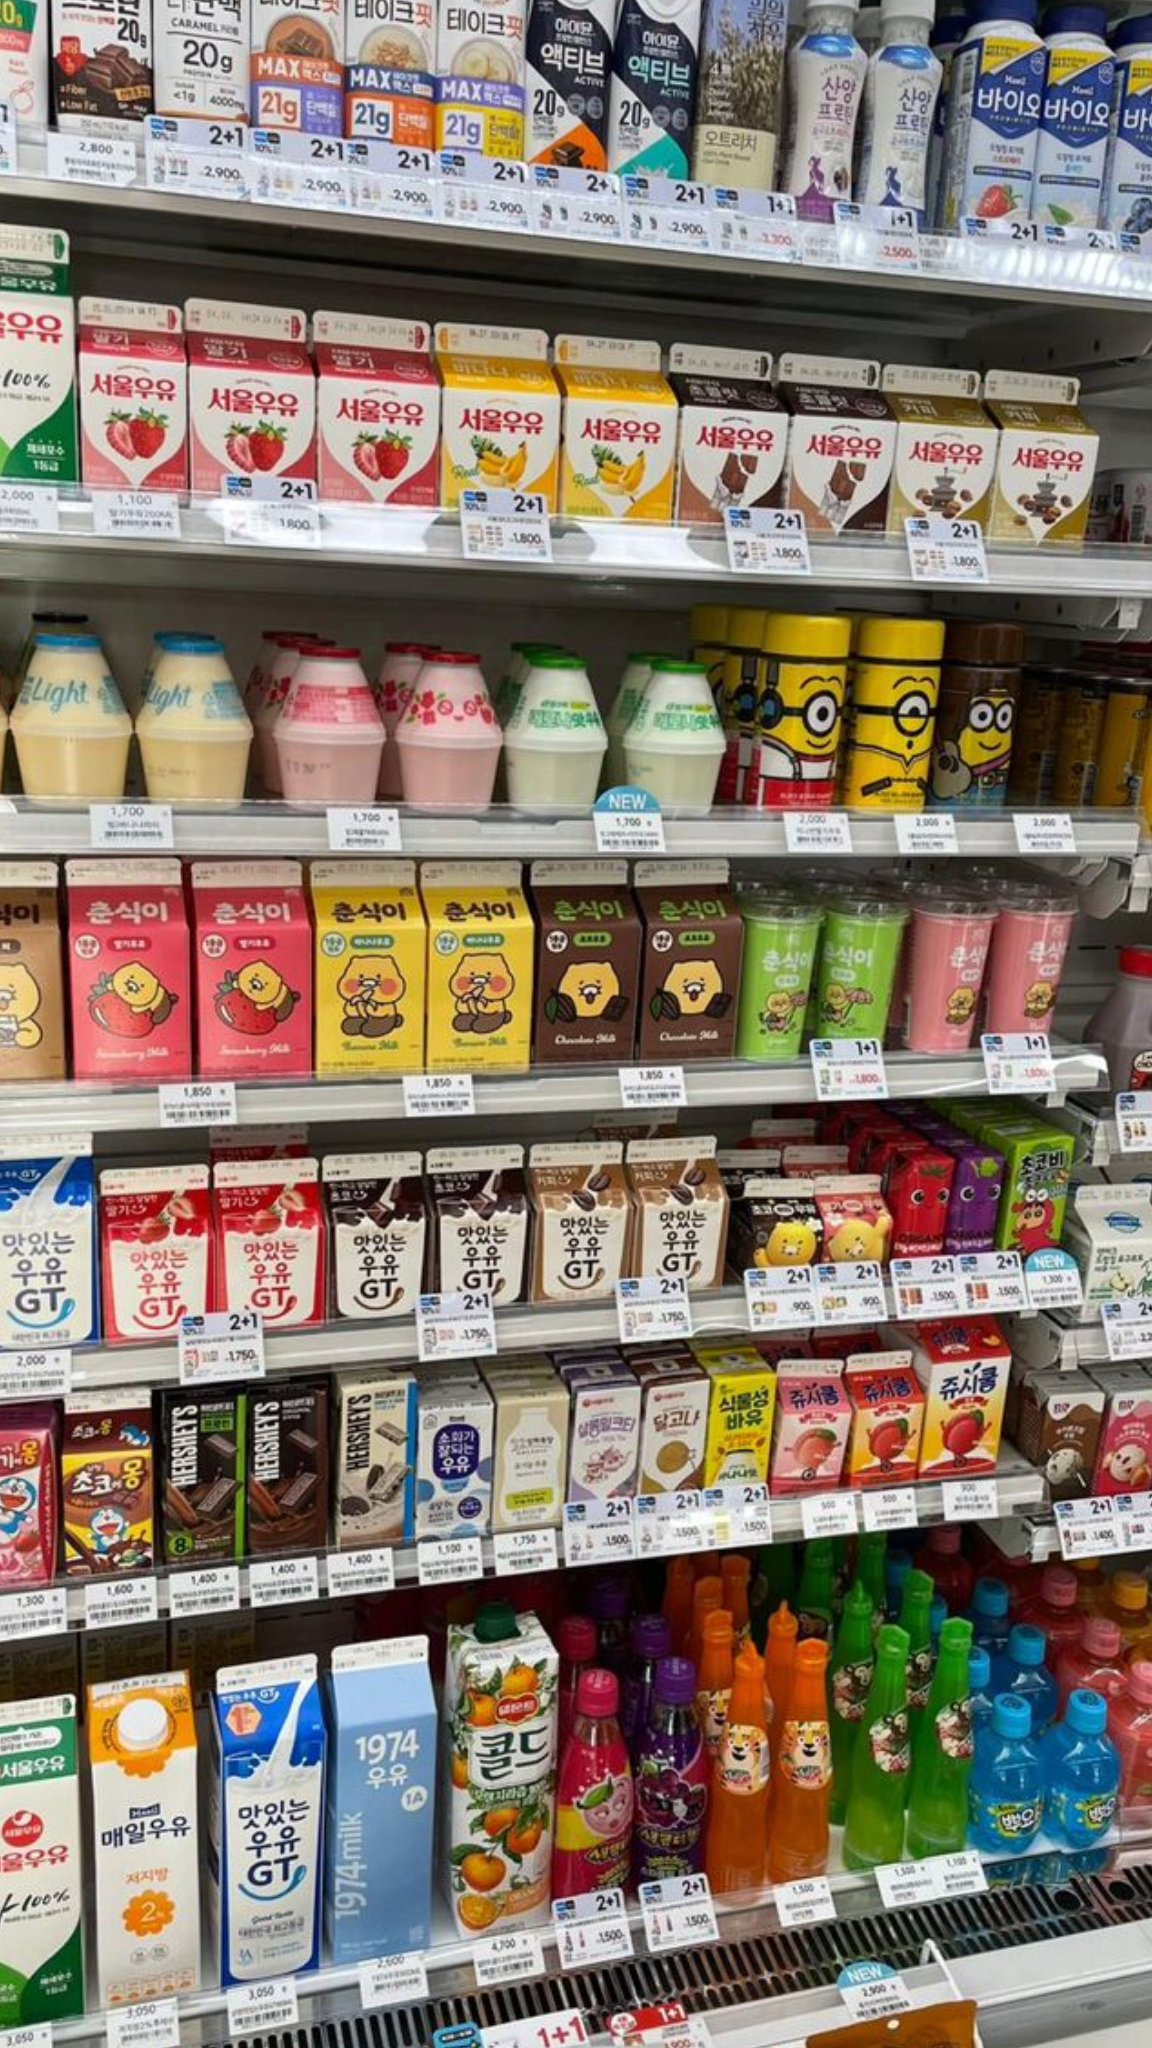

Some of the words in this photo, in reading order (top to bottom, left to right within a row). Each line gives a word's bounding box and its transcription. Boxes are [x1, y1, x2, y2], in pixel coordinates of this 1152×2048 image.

[117, 17, 147, 49] 20g
[171, 17, 219, 34] CARAMEL
[447, 8, 524, 40] 테이크핏
[182, 39, 234, 73] 20g
[540, 42, 605, 76] 액티브
[258, 58, 300, 79] MAX
[628, 54, 690, 88] 액티브
[349, 70, 391, 91] MAX
[441, 80, 482, 102] MAX
[574, 76, 605, 88] ACTIVE
[822, 76, 857, 103] 산양
[533, 89, 565, 118] 20g
[660, 87, 690, 100] ACTIVE
[899, 87, 933, 113] 산양
[978, 87, 1041, 119] 바이오
[261, 90, 298, 123] 21g
[619, 99, 651, 130] 20g
[1044, 98, 1110, 129] 바이오
[354, 102, 391, 134] 21g
[209, 125, 244, 148] 2+1
[445, 113, 482, 145] 21g
[79, 142, 114, 155] 2,800
[310, 138, 344, 160] 2+1
[705, 131, 758, 152] 오트리치
[397, 150, 431, 171] 2+1
[493, 162, 526, 184] 2+1
[674, 184, 706, 205] 2+1
[1011, 223, 1039, 241] 2+1
[91, 373, 176, 402] 서울우유
[207, 387, 299, 417] 서울우유
[336, 397, 424, 426] 서울우유
[459, 407, 544, 435] 서울우유
[580, 418, 662, 444] 서울우유
[696, 425, 775, 452] 서울우유
[806, 434, 882, 460] 서울우유
[909, 440, 984, 466] 서울우유
[1012, 446, 1085, 473] 서울우유
[117, 494, 153, 506] 1,100
[282, 480, 313, 501] 2+1
[513, 494, 544, 515] 2+1
[774, 513, 802, 531] 2+1
[950, 522, 979, 540] 2+1
[513, 530, 542, 545] 1,800
[776, 546, 802, 559] 1,800
[32, 675, 87, 716] Light
[110, 806, 145, 818] 1,700
[608, 793, 647, 811] NEW
[352, 812, 381, 824] 1,700
[615, 817, 641, 828] 1,700
[799, 814, 827, 825] 2,000
[86, 902, 168, 925] 춘식이
[213, 902, 291, 924] 춘식이
[331, 900, 407, 923] 춘식이
[443, 901, 516, 923] 춘식이
[553, 899, 624, 922] 춘식이
[659, 899, 727, 921] 춘식이
[856, 1040, 879, 1056] 1+1
[1024, 1035, 1047, 1051] 1+1
[425, 1077, 452, 1089] 1,850
[638, 1070, 664, 1081] 1,850
[183, 1086, 212, 1098] 1,850
[1021, 1151, 1064, 1177] 초코비
[560, 1216, 610, 1236] 맛있는
[660, 1210, 708, 1230] 맛있는
[2, 1232, 76, 1256] 맛있는
[354, 1233, 407, 1254] 맛있는
[457, 1225, 509, 1245] 맛있는
[662, 1229, 699, 1251] 우유
[244, 1241, 299, 1262] 맛있는
[462, 1245, 503, 1267] 우유
[564, 1236, 603, 1258] 우유
[130, 1249, 189, 1272] 맛있는
[358, 1254, 400, 1277] 우유
[564, 1260, 600, 1280] GT
[662, 1252, 698, 1272] GT
[931, 1258, 954, 1274] 2+1
[996, 1254, 1020, 1270] 2+1
[1034, 1255, 1065, 1268] NEW
[11, 1257, 67, 1286] 우유
[249, 1262, 293, 1285] 우유
[463, 1269, 500, 1290] GT
[787, 1269, 811, 1285] 2+1
[856, 1264, 880, 1280] 2+1
[138, 1271, 182, 1295] 우유
[360, 1278, 399, 1300] GT
[660, 1277, 686, 1294] 2+1
[14, 1287, 67, 1315] GT
[140, 1295, 182, 1318] GT
[251, 1286, 291, 1309] GT
[463, 1293, 490, 1310] 2+1
[229, 1313, 258, 1331] 2+1
[662, 1311, 685, 1323] 1,750
[464, 1328, 489, 1341] 1,750
[17, 1355, 46, 1367] 2,000
[939, 1362, 999, 1401] 쥬시쿨
[719, 1389, 770, 1411] 식물성
[789, 1383, 840, 1411] 쥬시쿨
[652, 1409, 701, 1432] 달고나
[726, 1413, 763, 1431] 바유
[253, 1400, 280, 1481] HERSHEY'S
[345, 1393, 372, 1472] HERSHEY'S
[437, 1430, 475, 1445] 소화가
[170, 1403, 198, 1487] HERSHEY'S
[437, 1443, 475, 1458] 잘되는
[440, 1456, 471, 1476] 우유
[676, 1493, 700, 1510] 2+1
[743, 1486, 767, 1503] 2+1
[606, 1501, 631, 1517] 2+1
[1090, 1500, 1112, 1514] 2+1
[512, 1535, 537, 1545] 1,750
[270, 1563, 296, 1575] 1,400
[347, 1553, 373, 1566] 1,400
[191, 1573, 218, 1586] 1,400
[17, 1594, 44, 1608] 1,300
[107, 1584, 133, 1597] 1,600
[355, 1729, 419, 1765] 1974
[475, 1725, 551, 1781] 콜드
[1, 1756, 66, 1779] 서울우유
[366, 1764, 409, 1790] 우유
[405, 1791, 424, 1806] 1A
[238, 1799, 310, 1830] 맛있는
[101, 1816, 192, 1848] 매일우유
[245, 1825, 301, 1860] 우유
[0, 1845, 69, 1873] 울우유
[335, 1811, 368, 1920] 1974milk
[124, 1867, 169, 1884] 저지방
[247, 1855, 299, 1887] GT
[681, 1878, 707, 1897] 2+1
[596, 1892, 622, 1912] 2+1
[491, 1938, 516, 1952] 4,700
[846, 1966, 883, 1983] NEW
[248, 1985, 275, 2000] 3,050
[127, 2003, 156, 2019] 3,050
[660, 2006, 687, 2024] 1+1
[6, 2032, 35, 2047] 3,050
[535, 2015, 586, 2048] 1+1
